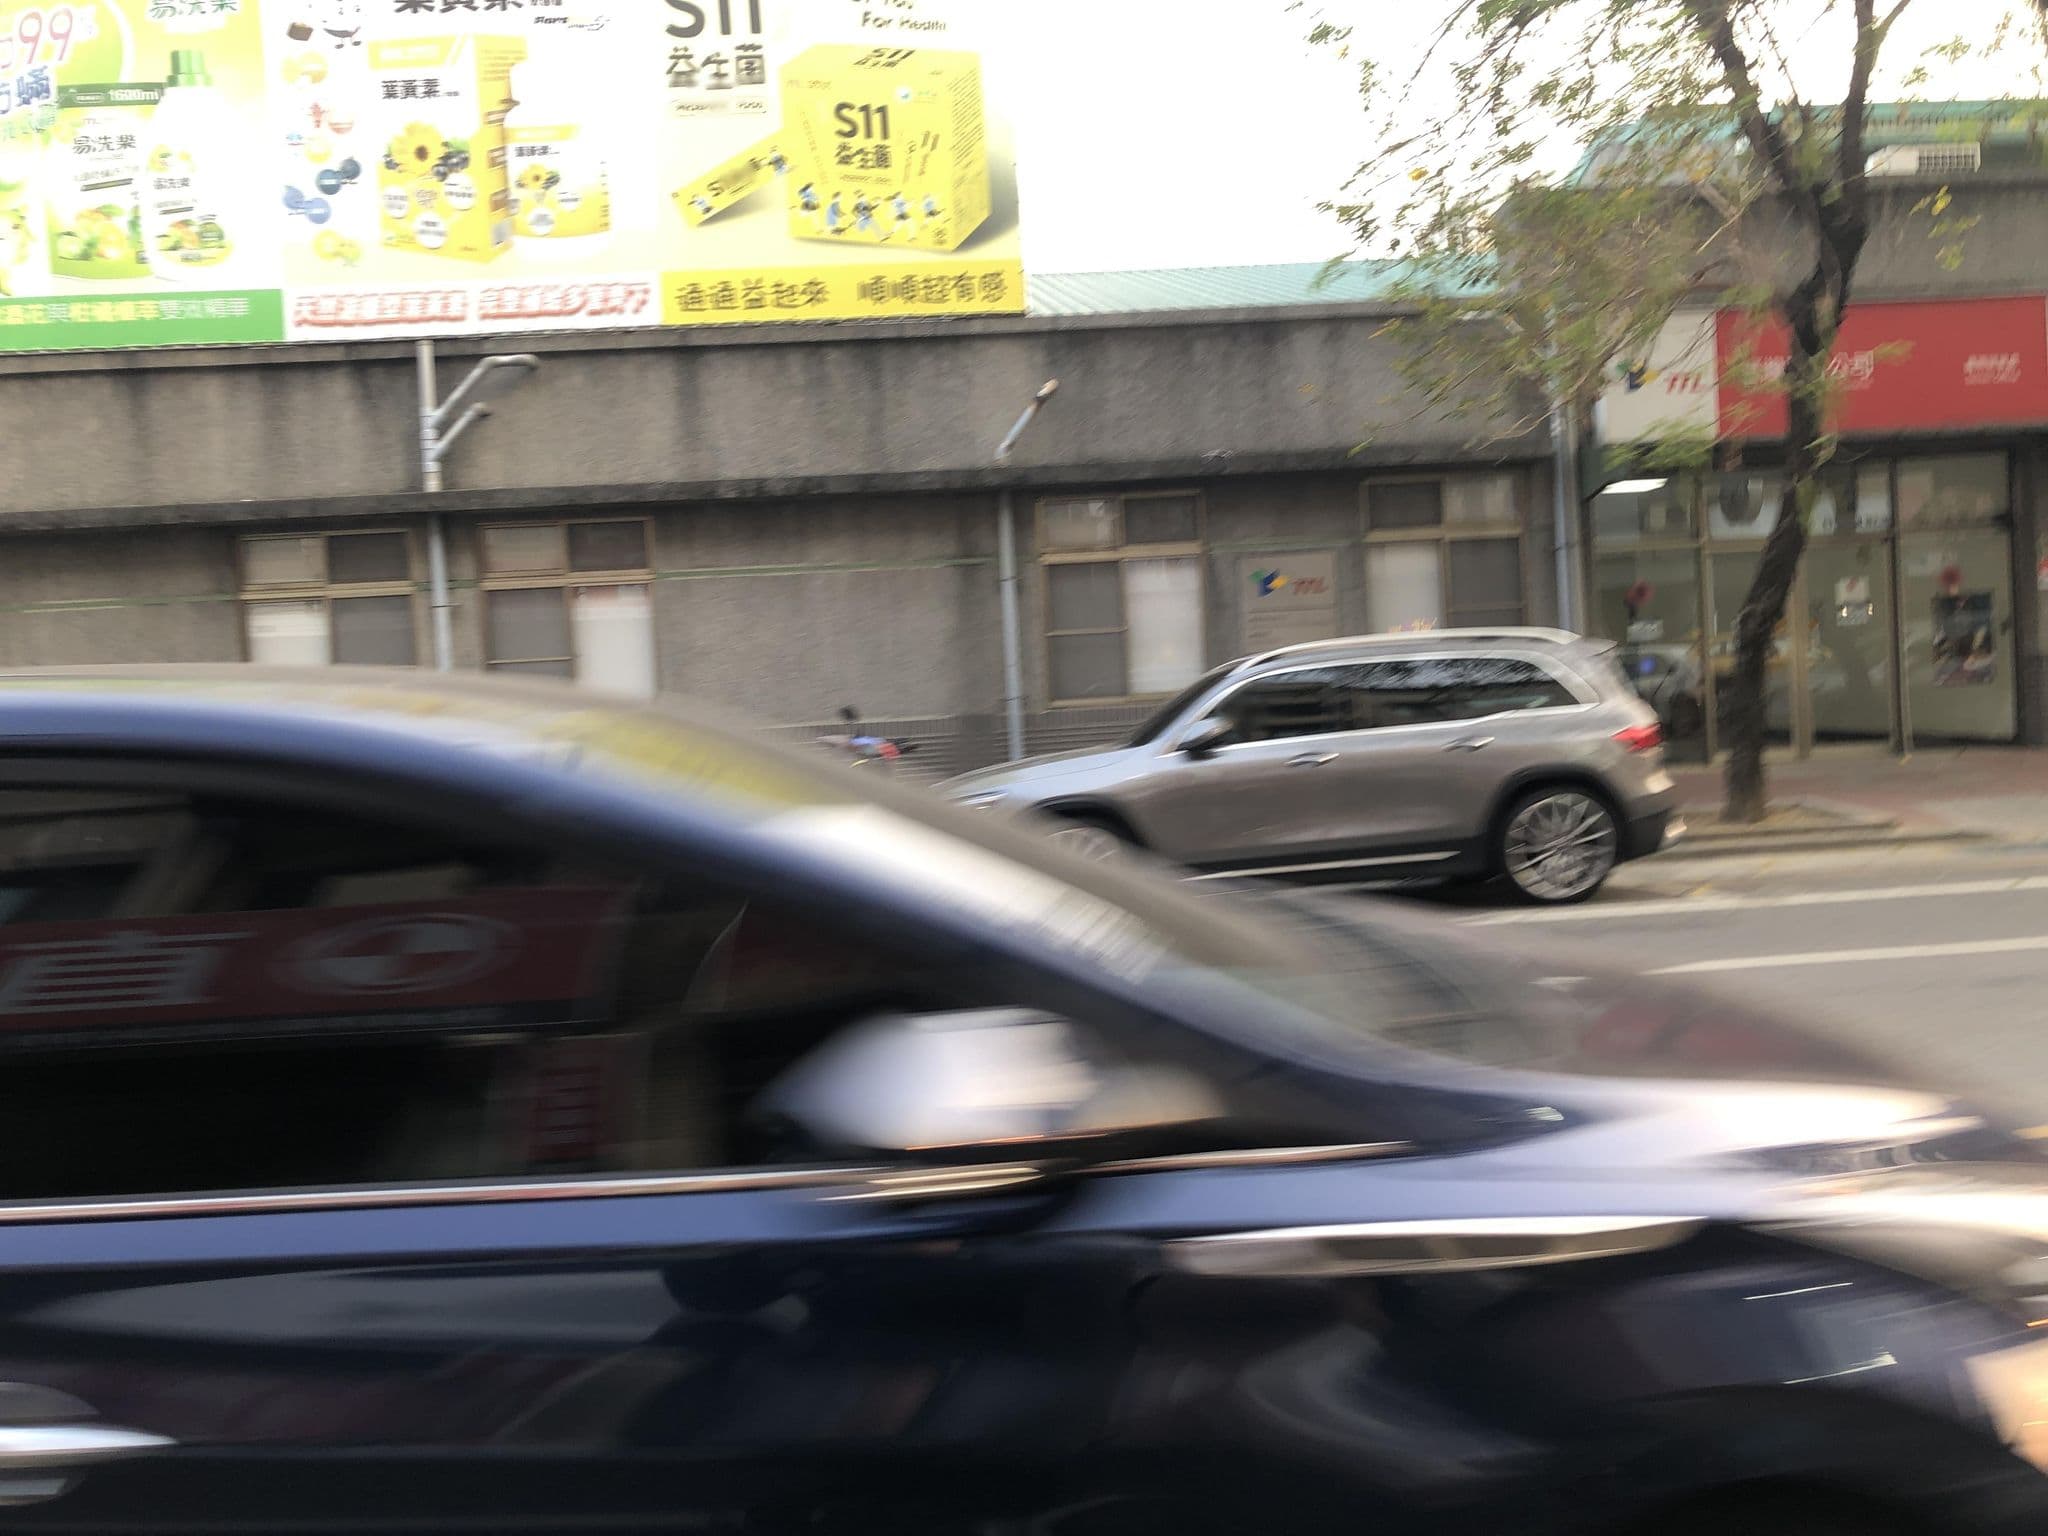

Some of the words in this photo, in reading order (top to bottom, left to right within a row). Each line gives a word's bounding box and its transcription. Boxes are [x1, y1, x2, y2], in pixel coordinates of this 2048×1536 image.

[665, 43, 766, 91] 益生菌
[833, 101, 891, 140] S11
